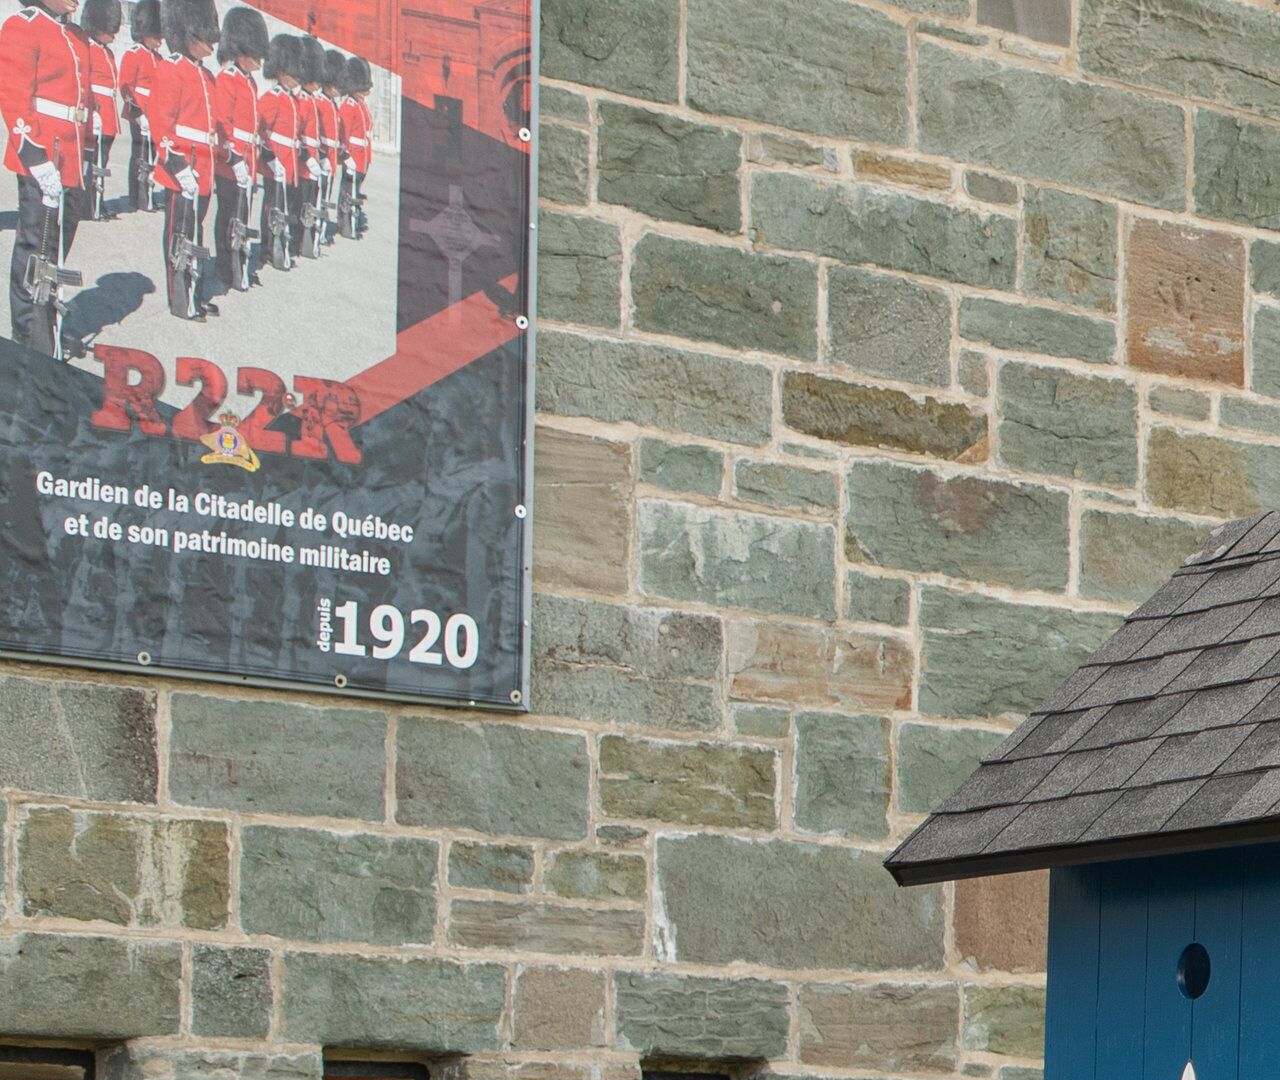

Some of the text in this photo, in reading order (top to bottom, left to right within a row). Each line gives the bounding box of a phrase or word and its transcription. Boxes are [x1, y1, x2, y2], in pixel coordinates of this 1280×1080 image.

[91, 343, 362, 465] R22R
[36, 471, 414, 543] Gardien de la Citadelle de Québec
[64, 514, 391, 575] et de son patrimoine militaire
[317, 598, 333, 652] depuis
[334, 600, 479, 669] 1920
